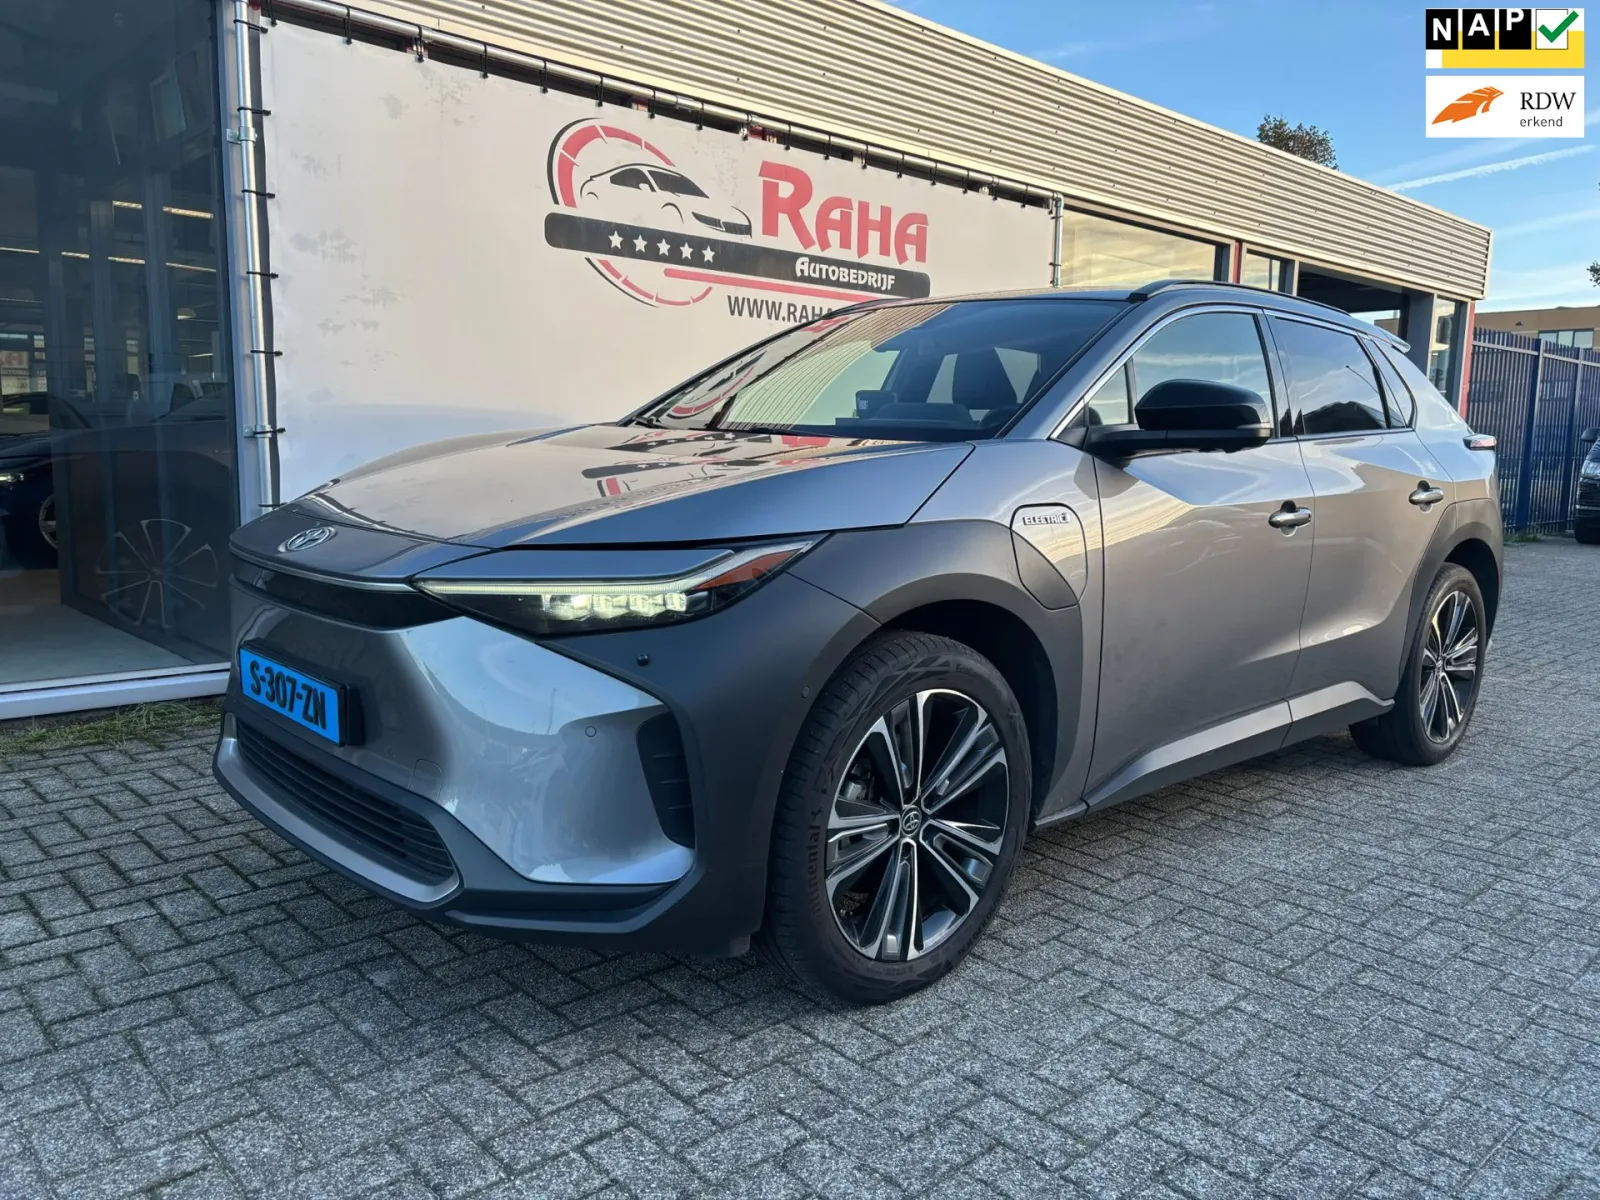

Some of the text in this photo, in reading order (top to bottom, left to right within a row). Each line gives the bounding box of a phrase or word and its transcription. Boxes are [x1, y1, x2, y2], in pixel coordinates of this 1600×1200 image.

[758, 160, 929, 265] RAHA
[795, 257, 896, 291] AUTOBEDRIJF
[250, 660, 327, 730] S-307-ZN
